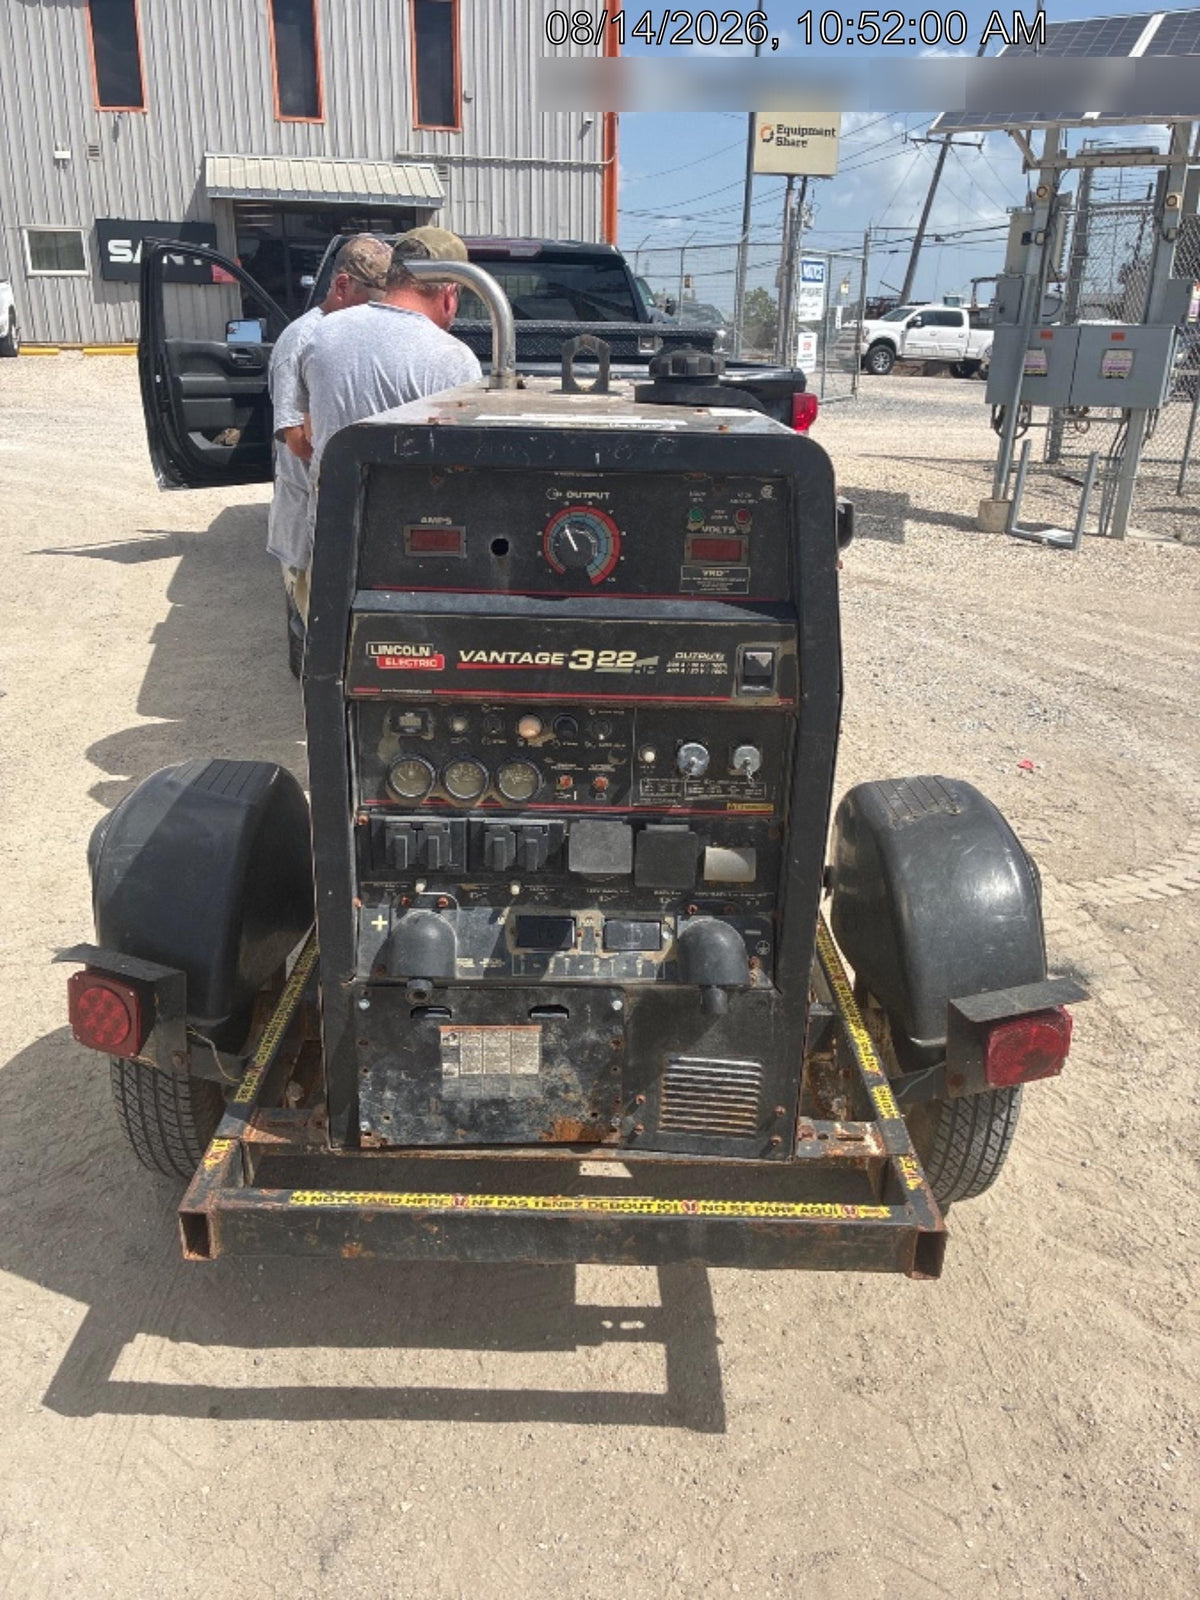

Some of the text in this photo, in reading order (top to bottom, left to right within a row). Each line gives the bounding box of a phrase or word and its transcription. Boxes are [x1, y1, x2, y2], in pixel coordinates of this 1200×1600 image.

[776, 123, 837, 138] Equipment
[775, 136, 809, 149] Share
[566, 489, 611, 500] OUTPUT
[420, 516, 453, 526] AMPS
[702, 525, 737, 534] VOLTS
[370, 644, 432, 657] LINCOLN
[384, 657, 438, 668] ELECTRIC
[459, 649, 566, 666] VANTAGE
[568, 648, 638, 671] 322
[496, 1199, 529, 1209] PAS
[587, 1200, 653, 1210] DEBOUT
[702, 1203, 730, 1212] NO
